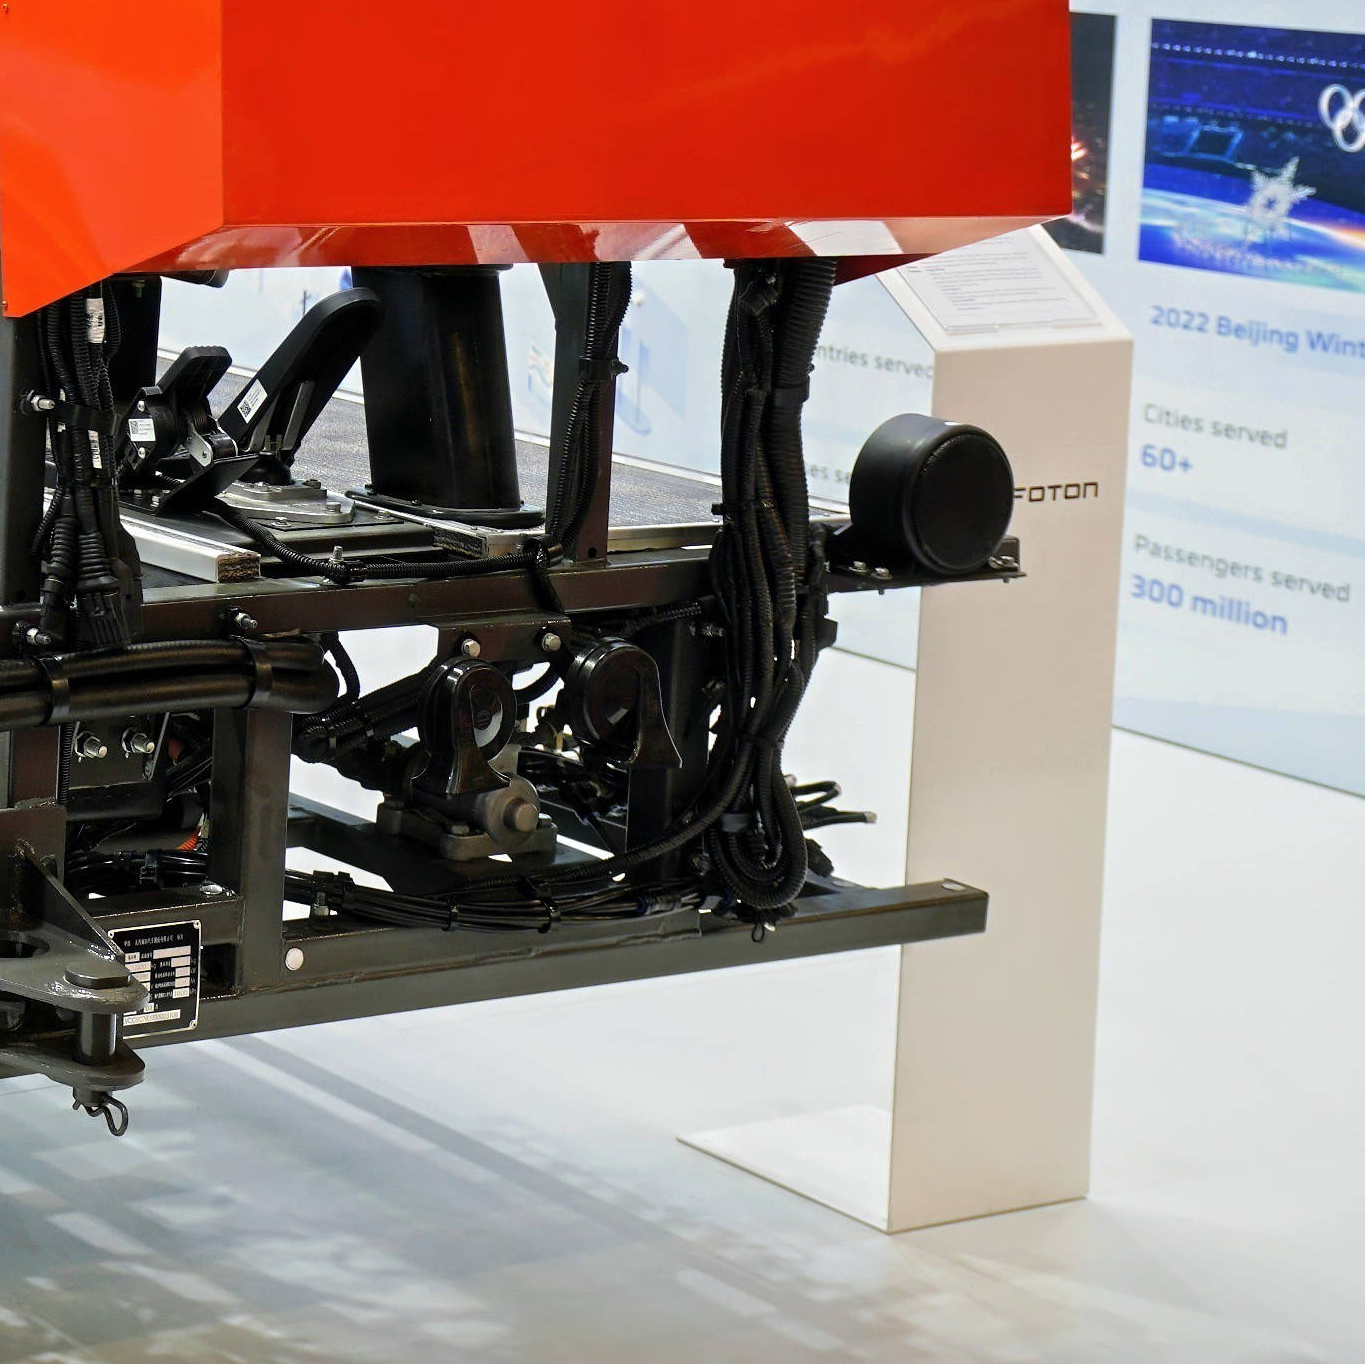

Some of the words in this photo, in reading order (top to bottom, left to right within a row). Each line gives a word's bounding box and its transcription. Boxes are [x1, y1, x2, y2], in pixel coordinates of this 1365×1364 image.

[1150, 305, 1209, 334] 2022
[1215, 316, 1299, 354] Beijing
[1143, 402, 1205, 435] Cities
[1210, 419, 1288, 451] served
[1140, 443, 1194, 474] 60+
[1135, 533, 1265, 587] Passengers
[1271, 568, 1352, 604] served
[1130, 574, 1183, 610] 300
[1191, 592, 1289, 637] million
